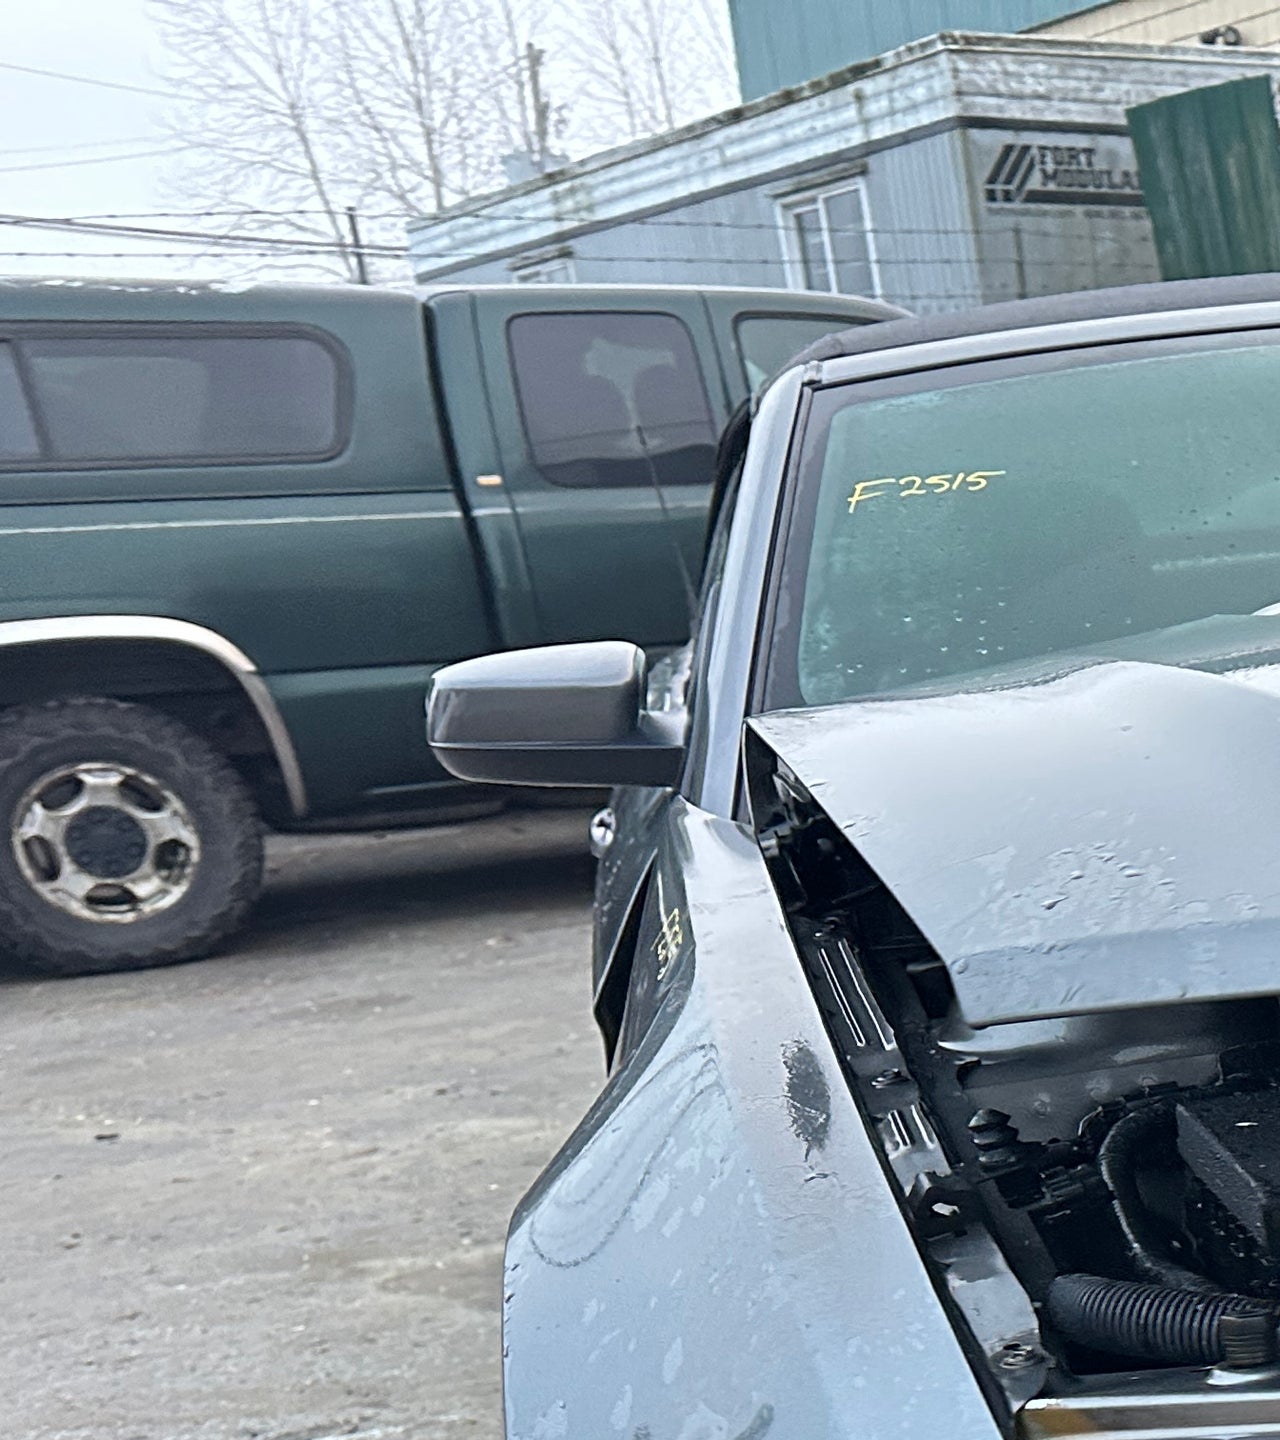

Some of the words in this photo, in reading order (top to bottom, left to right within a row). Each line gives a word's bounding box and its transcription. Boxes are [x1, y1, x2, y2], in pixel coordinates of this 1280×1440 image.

[1037, 145, 1096, 168] FORT
[1039, 167, 1140, 191] MODULA
[847, 470, 1006, 514] F2515
